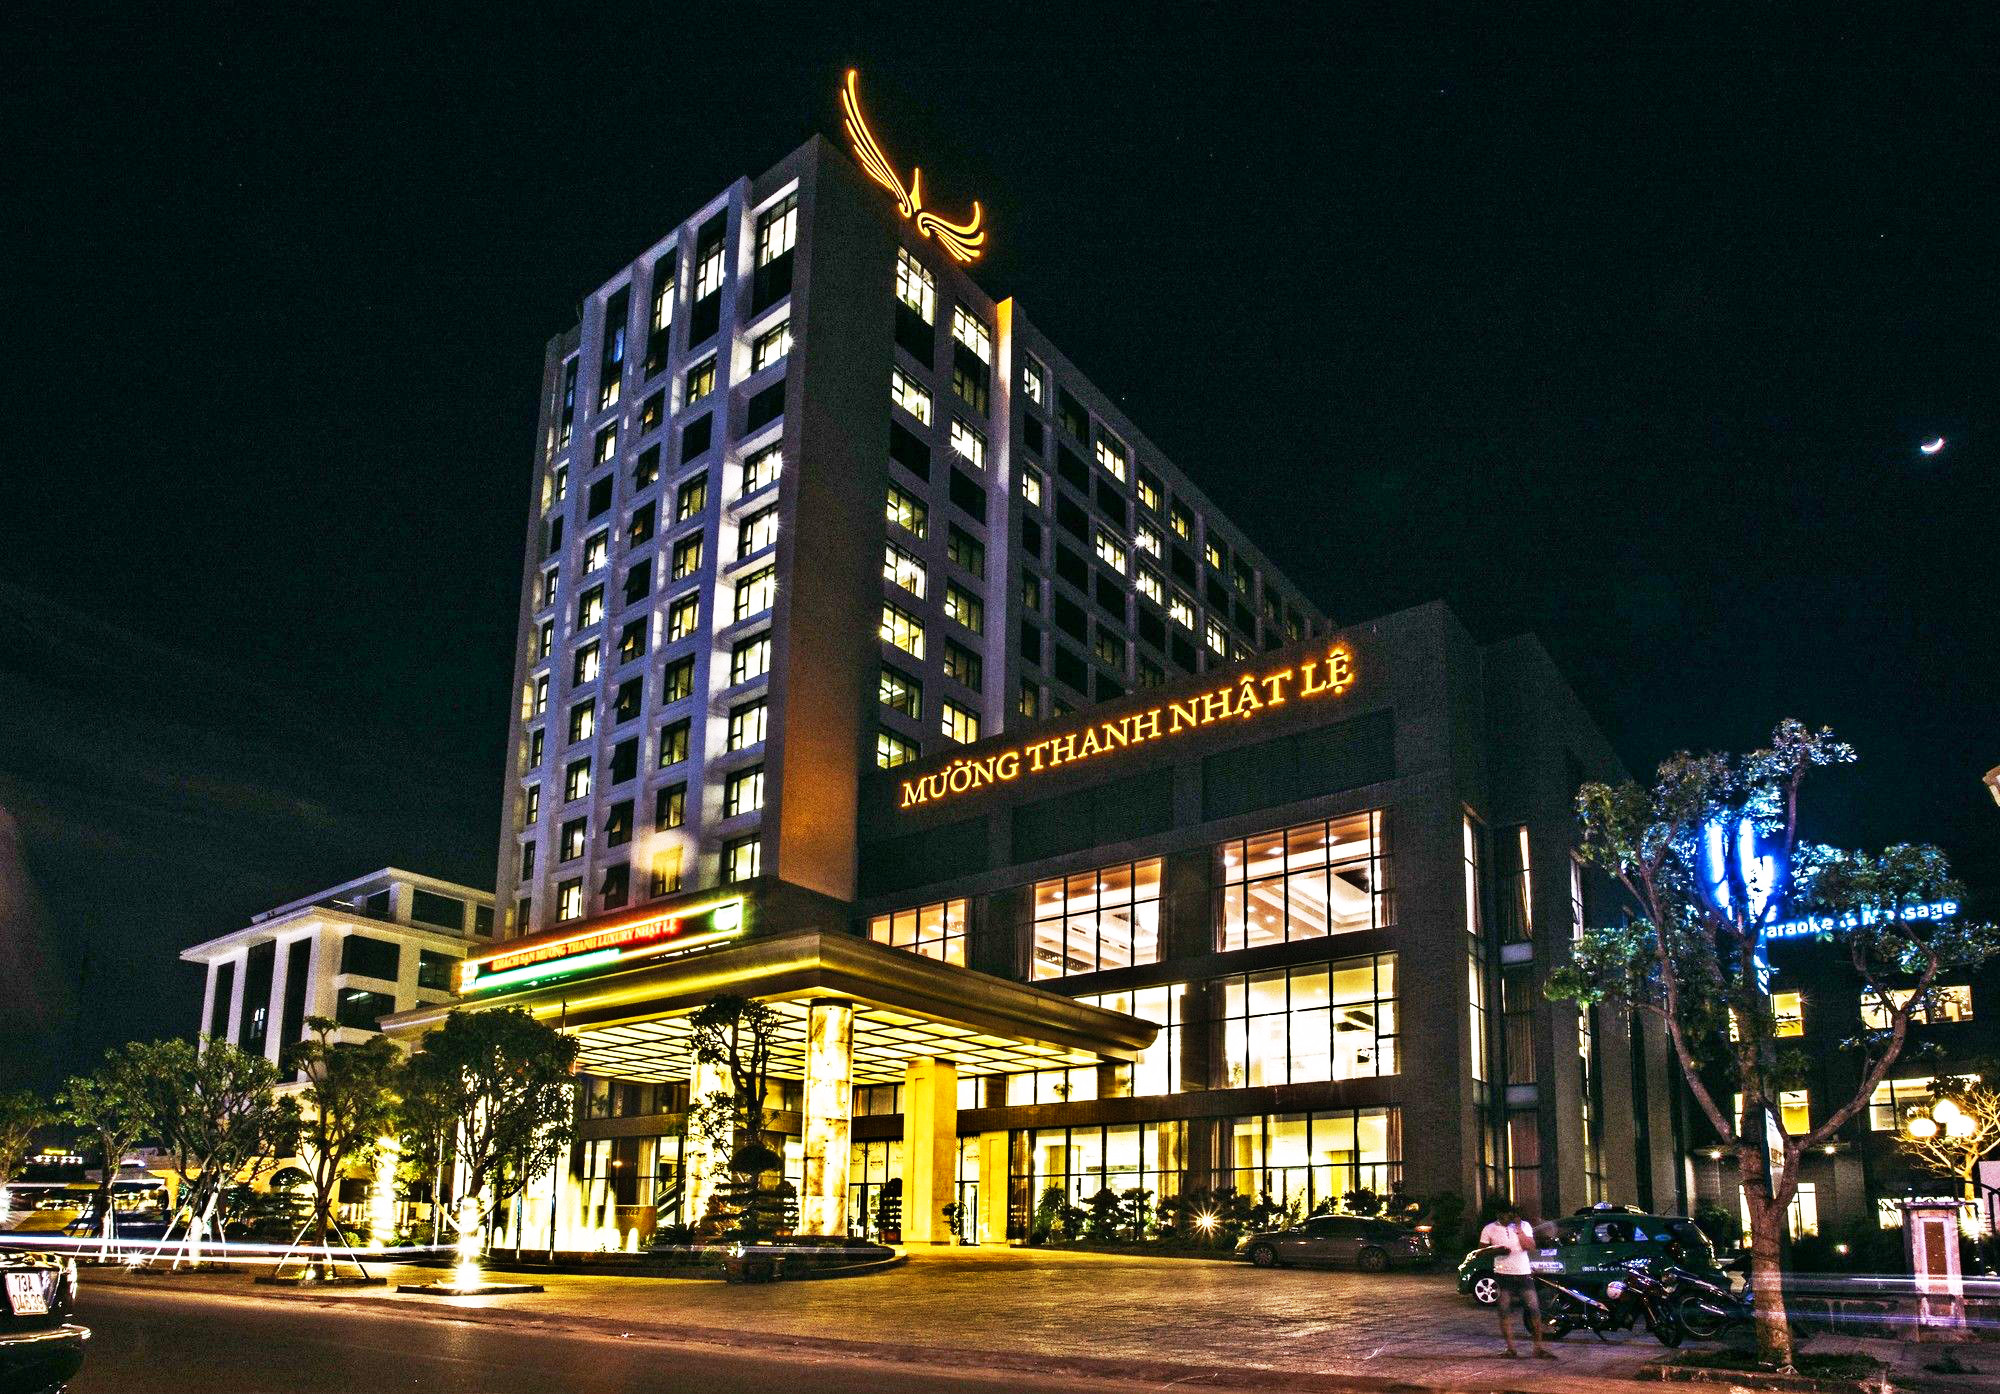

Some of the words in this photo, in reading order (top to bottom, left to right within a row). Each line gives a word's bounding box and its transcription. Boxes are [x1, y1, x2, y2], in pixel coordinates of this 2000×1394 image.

[900, 751, 1020, 808] MƯỜNG
[1025, 709, 1162, 772] THANH
[1168, 670, 1293, 733] NHẬT
[1300, 648, 1355, 696] LỆ
[597, 929, 634, 947] LUXURY
[1759, 916, 1834, 938] araoke
